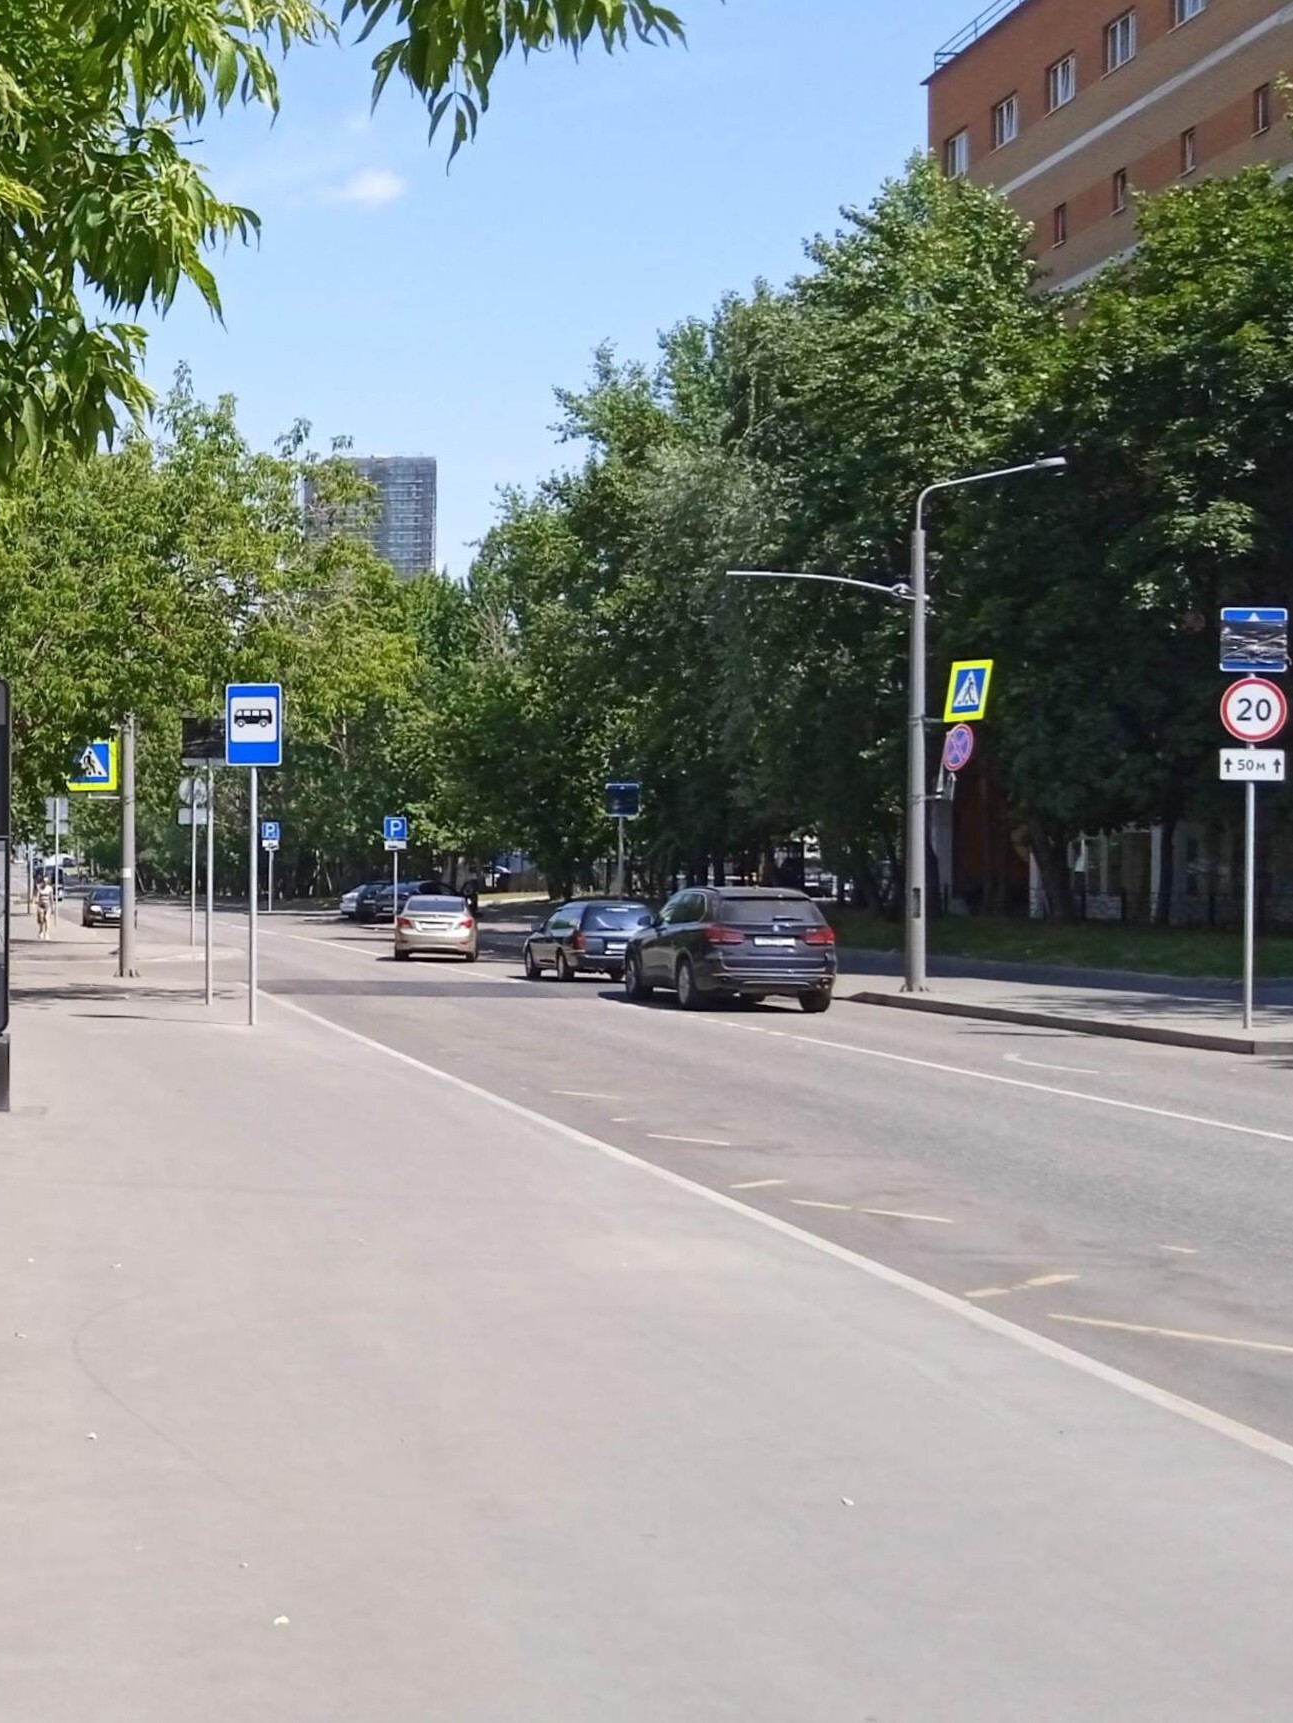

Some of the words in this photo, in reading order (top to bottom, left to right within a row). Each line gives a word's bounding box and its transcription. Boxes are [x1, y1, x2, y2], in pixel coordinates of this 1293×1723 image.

[1236, 698, 1272, 722] 20
[265, 823, 275, 838] P
[389, 819, 402, 837] P
